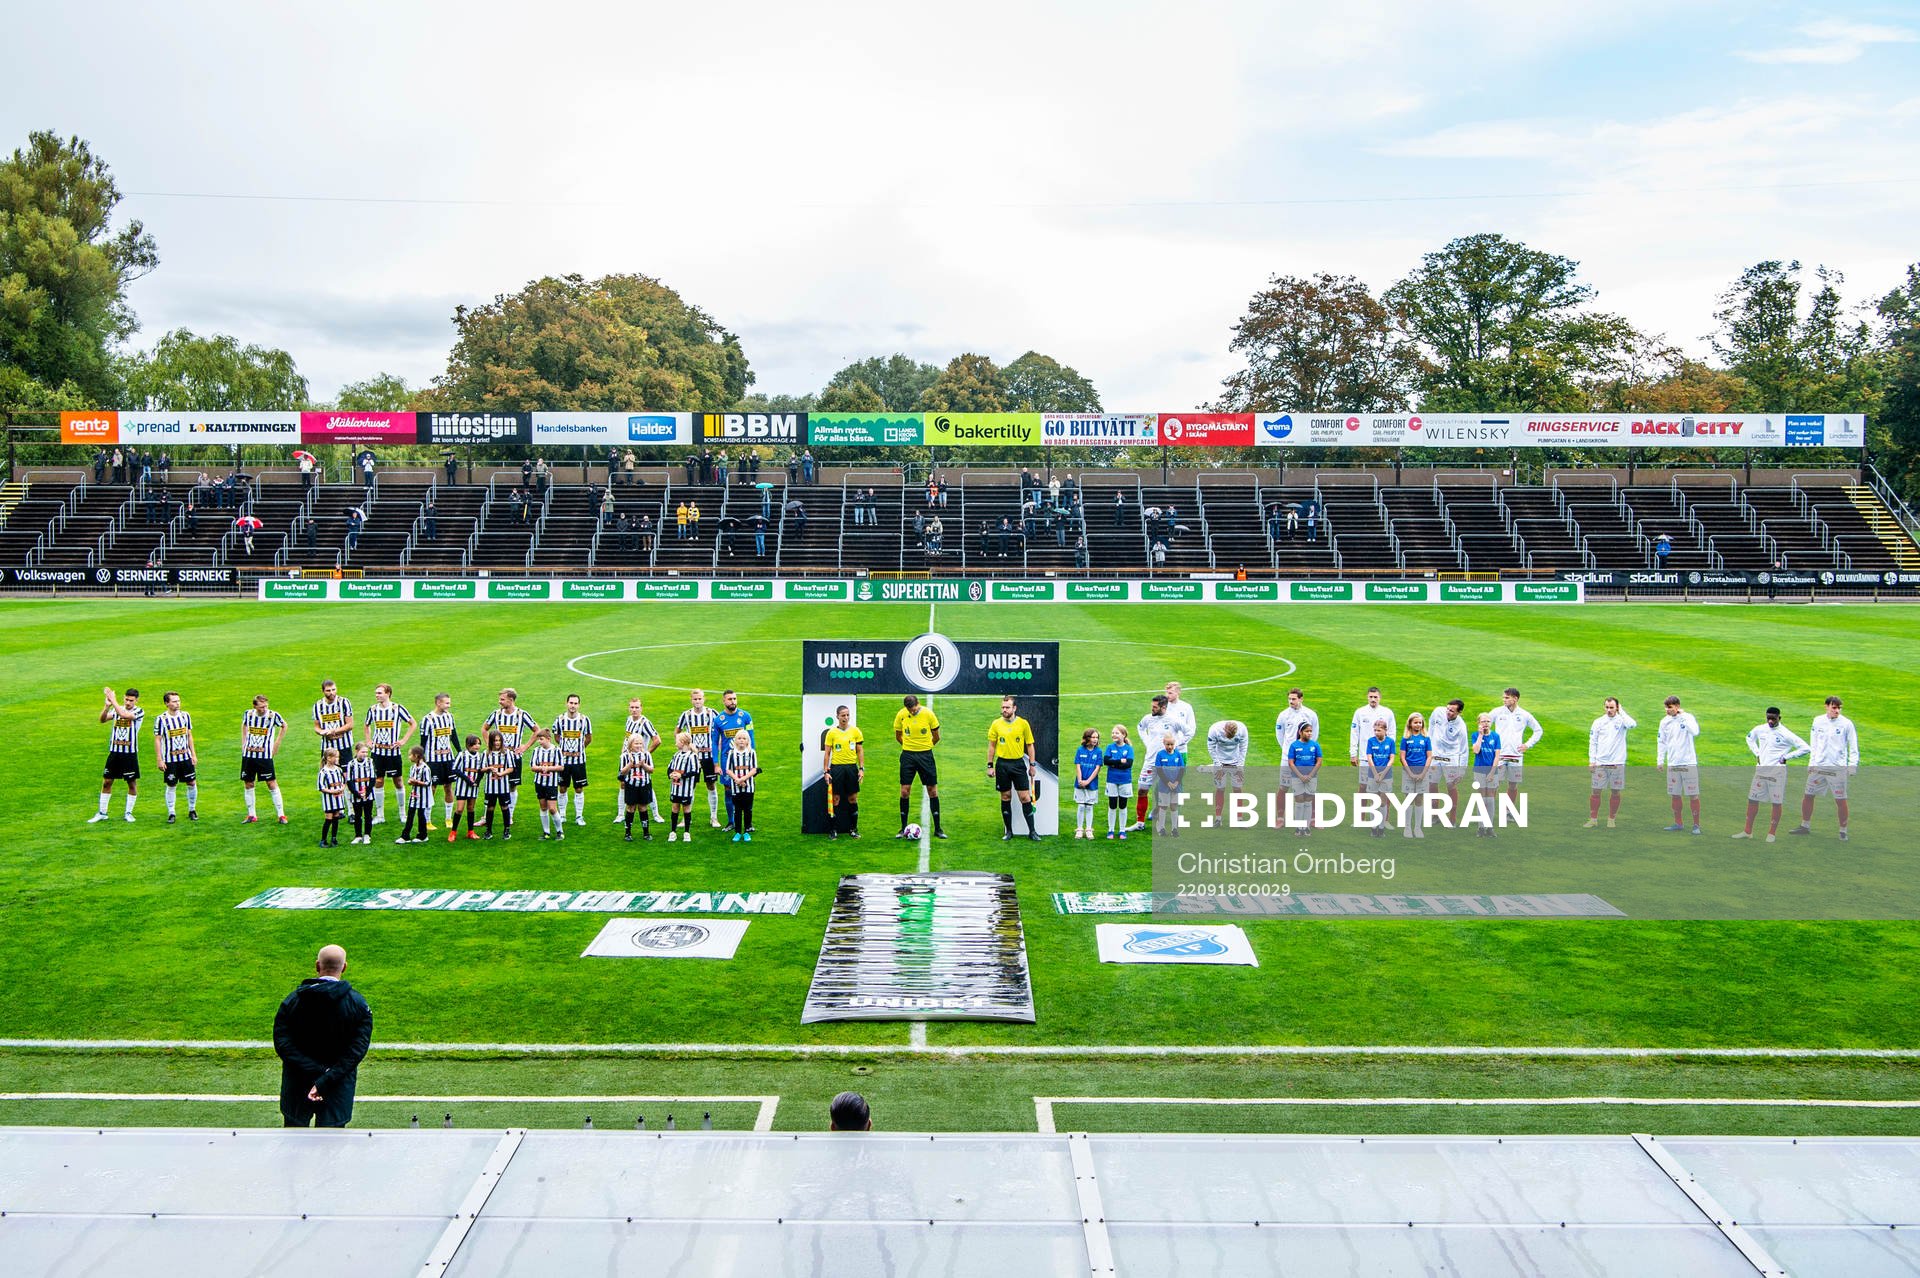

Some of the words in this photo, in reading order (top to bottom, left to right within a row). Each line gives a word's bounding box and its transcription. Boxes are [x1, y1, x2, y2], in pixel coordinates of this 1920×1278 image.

[69, 419, 110, 432] renta
[137, 420, 180, 436] prenad
[325, 417, 391, 430] Mäklarhuset
[431, 414, 517, 438] infosign
[536, 424, 608, 434] Handelsbanken
[631, 423, 673, 435] Haldex
[724, 414, 797, 437] BBM
[1045, 420, 1065, 436] GO
[1069, 417, 1137, 436] BILTVÄTT
[1266, 423, 1290, 431] arema
[1310, 419, 1344, 429] COMFORT
[1372, 419, 1406, 429] COMFORT
[1527, 421, 1620, 433] RINGSERVICE
[1631, 419, 1680, 435] DÄCK
[1695, 422, 1744, 435] CITY
[814, 425, 843, 434] Allmän
[844, 426, 869, 436] nytta.
[954, 424, 1032, 442] bakertilly
[1425, 428, 1510, 440] WILENSKY
[814, 434, 828, 442] För
[829, 434, 848, 442] allas
[15, 569, 86, 583] Volkswagen
[116, 570, 169, 582] SERNEKE
[178, 570, 231, 582] SERNEKE
[1563, 572, 1613, 584] stadium
[1629, 572, 1679, 584] stadium
[1703, 576, 1747, 584] Borstahusen
[1772, 576, 1816, 584] Borstahusen
[273, 583, 308, 591] ÅhusTurf
[308, 583, 319, 591] AB
[347, 583, 382, 591] ÅhusTurf
[383, 583, 393, 591] AB
[422, 583, 456, 591] ÅhusTurf
[496, 583, 531, 591] ÅhusTurf
[718, 584, 754, 592] ÅhusTurf
[754, 584, 765, 592] AB
[793, 584, 828, 592] ÅhusTurf
[829, 584, 839, 592] AB
[882, 583, 959, 600] SUPERETTAN
[1000, 584, 1034, 592] ÅhusTurf
[1074, 584, 1109, 592] ÅhusTurf
[1298, 585, 1333, 593] ÅhusTurf
[1334, 585, 1344, 593] AB
[1373, 585, 1408, 593] ÅhusTurf
[1408, 585, 1419, 593] AB
[1448, 585, 1482, 593] ÅhusTurf
[1483, 585, 1494, 593] AB
[1522, 585, 1558, 593] ÅhusTurf
[816, 652, 888, 669] UNIBET
[974, 653, 1046, 670] UNIBET
[364, 890, 762, 912] SUPERETTAN
